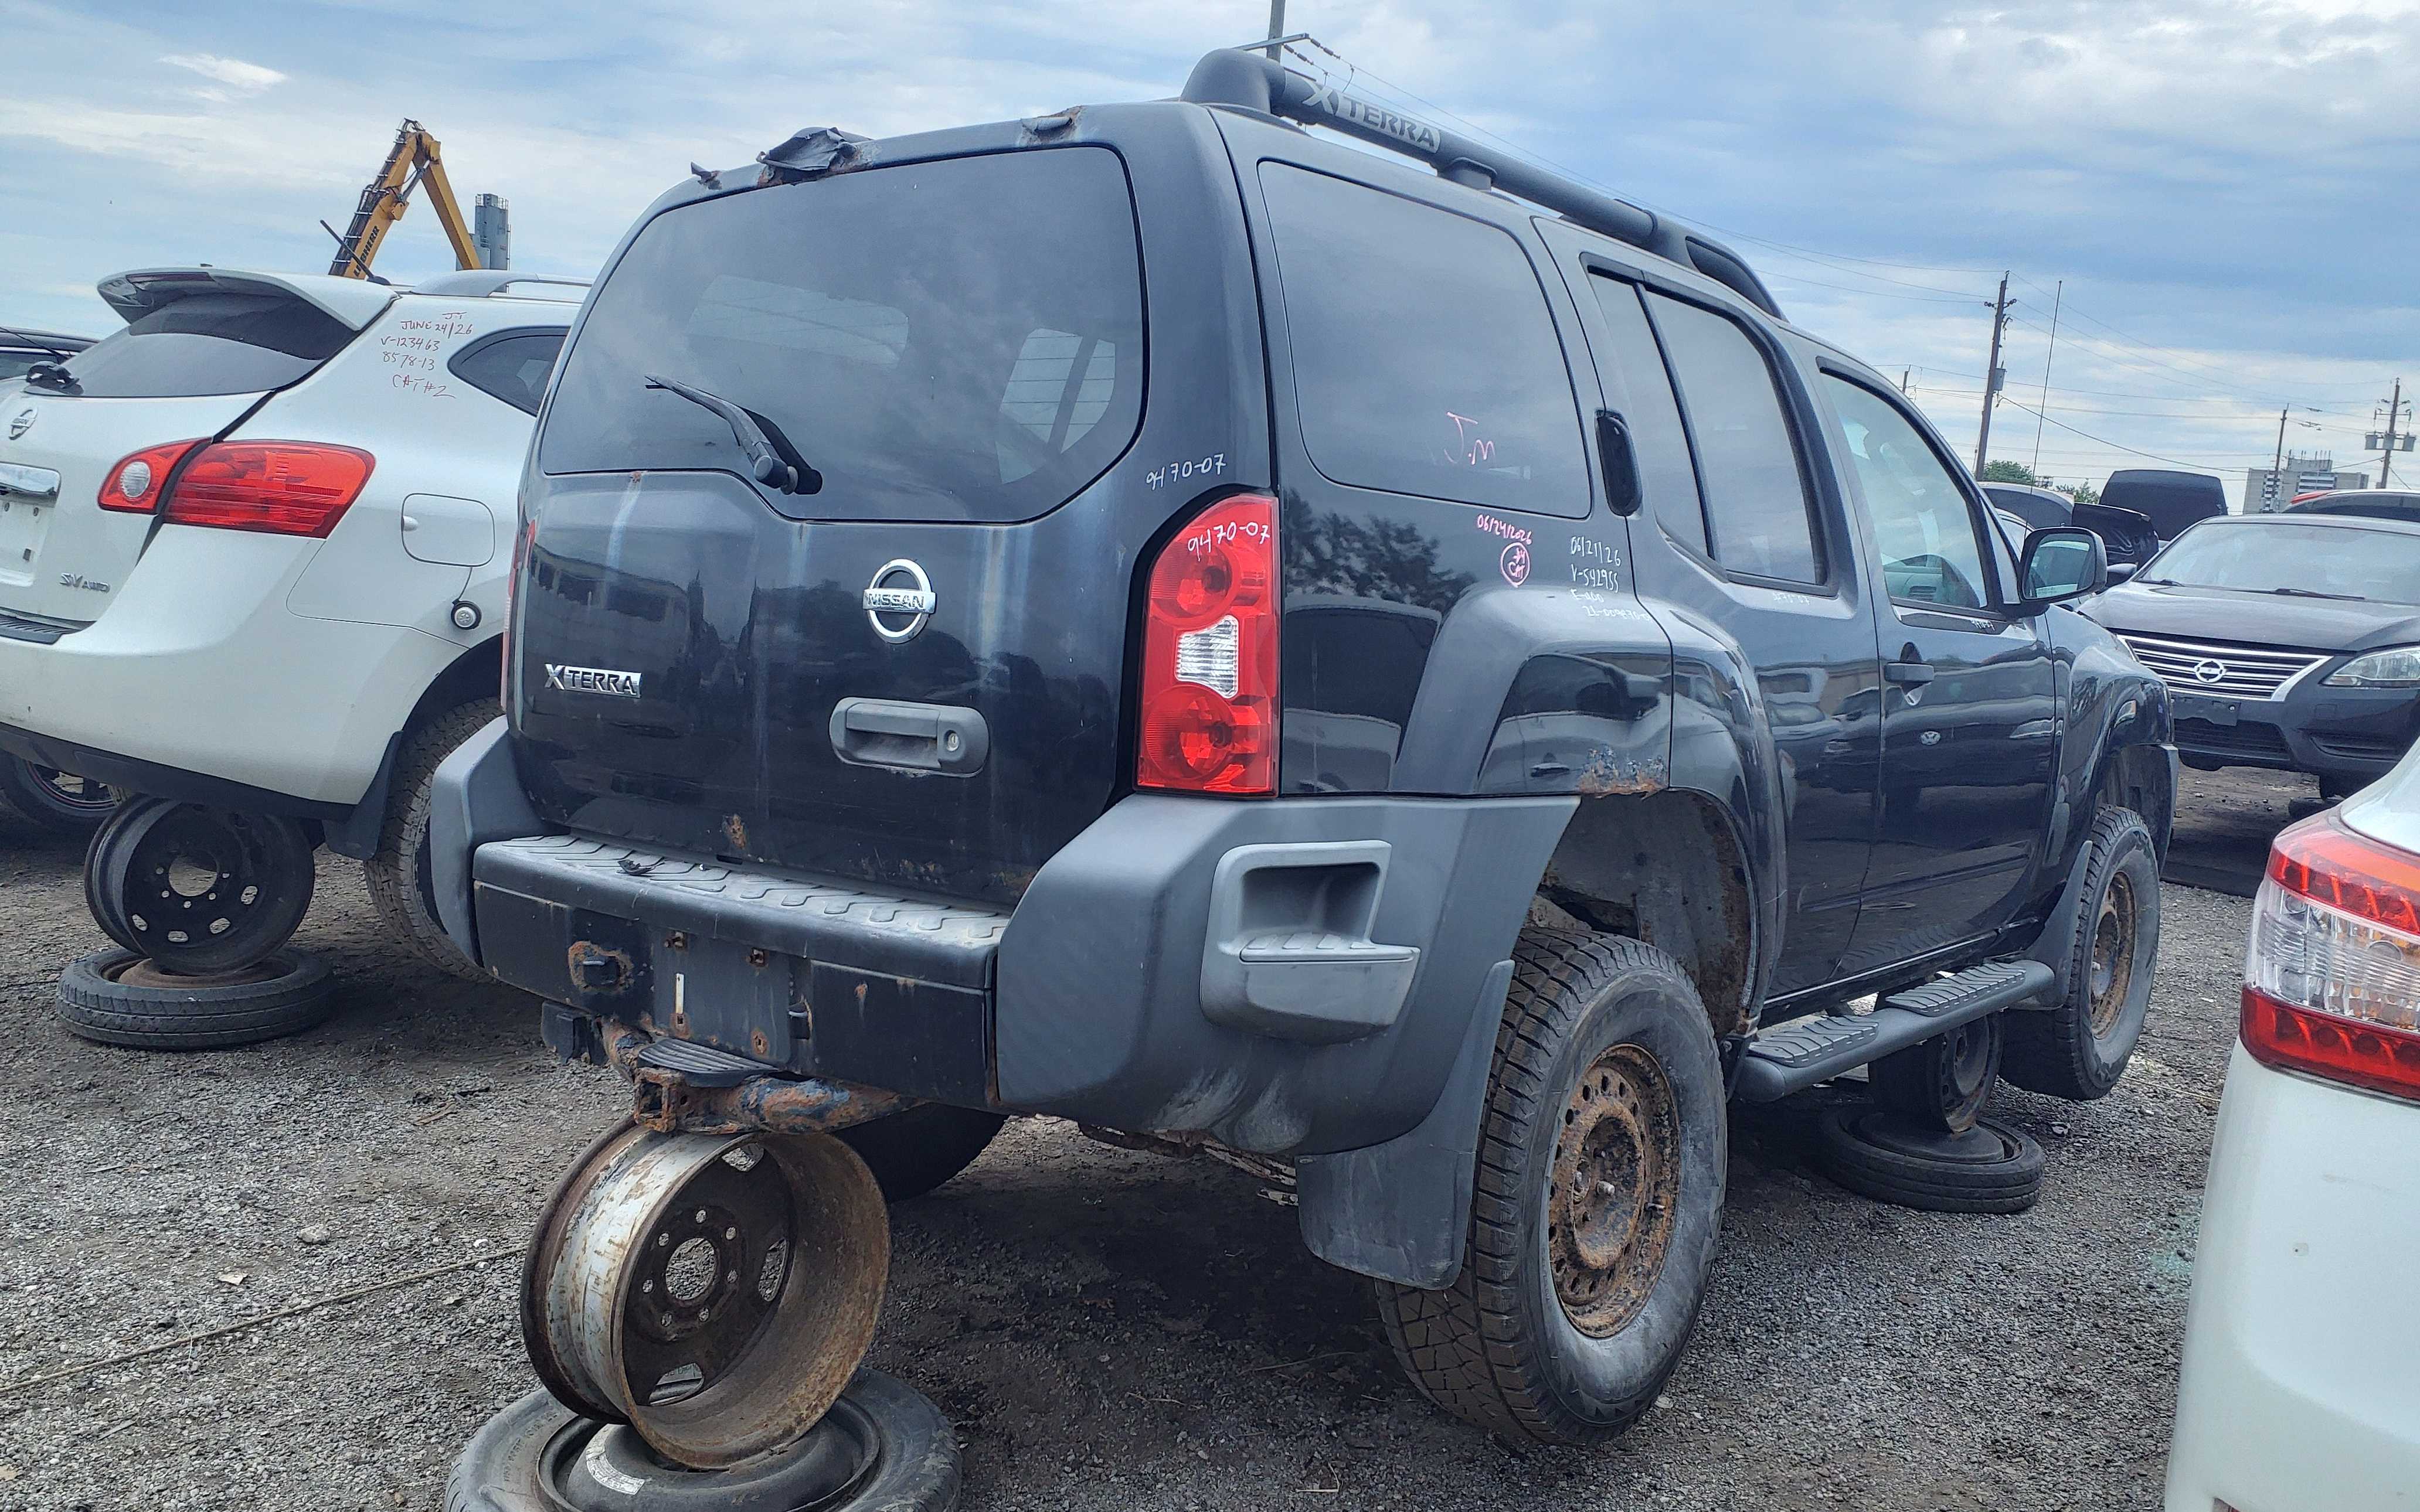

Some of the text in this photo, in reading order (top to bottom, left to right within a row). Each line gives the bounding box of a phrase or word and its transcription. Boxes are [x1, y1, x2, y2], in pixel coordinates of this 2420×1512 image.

[1301, 79, 1440, 154] XTERRA
[354, 226, 380, 277] LIBHERR
[400, 321, 473, 339] JUNE 24/26
[383, 352, 434, 370] 8578-13
[60, 573, 83, 587] SV
[868, 593, 925, 608] NISSAN
[544, 663, 643, 699] XTERRA
